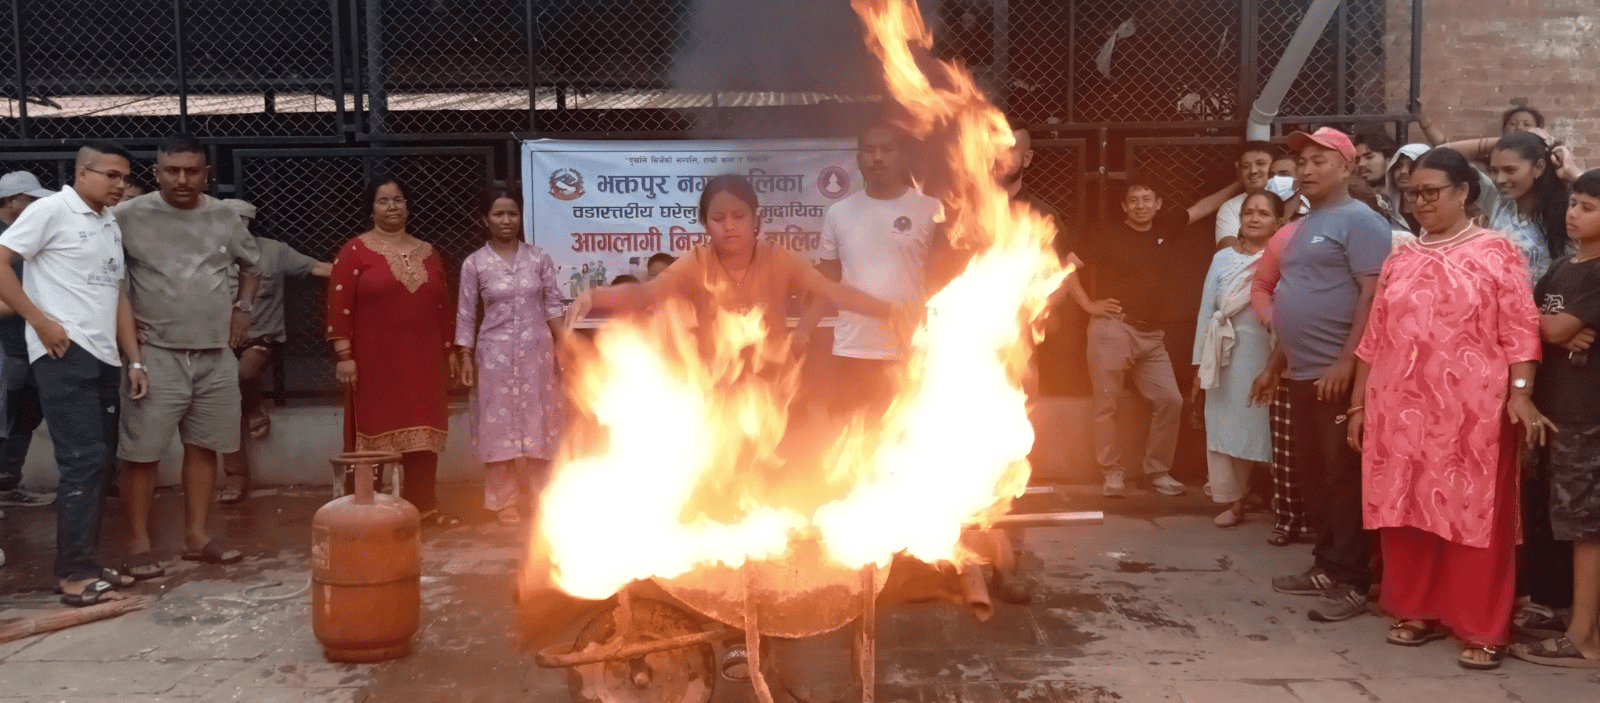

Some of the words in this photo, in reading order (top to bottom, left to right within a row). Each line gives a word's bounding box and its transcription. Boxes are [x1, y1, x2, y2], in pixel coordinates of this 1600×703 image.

[597, 175, 670, 199] भक्तपुर
[572, 203, 654, 219] वडास्तरीय
[660, 203, 698, 224] घरेलु
[570, 227, 663, 253] आगलागी
